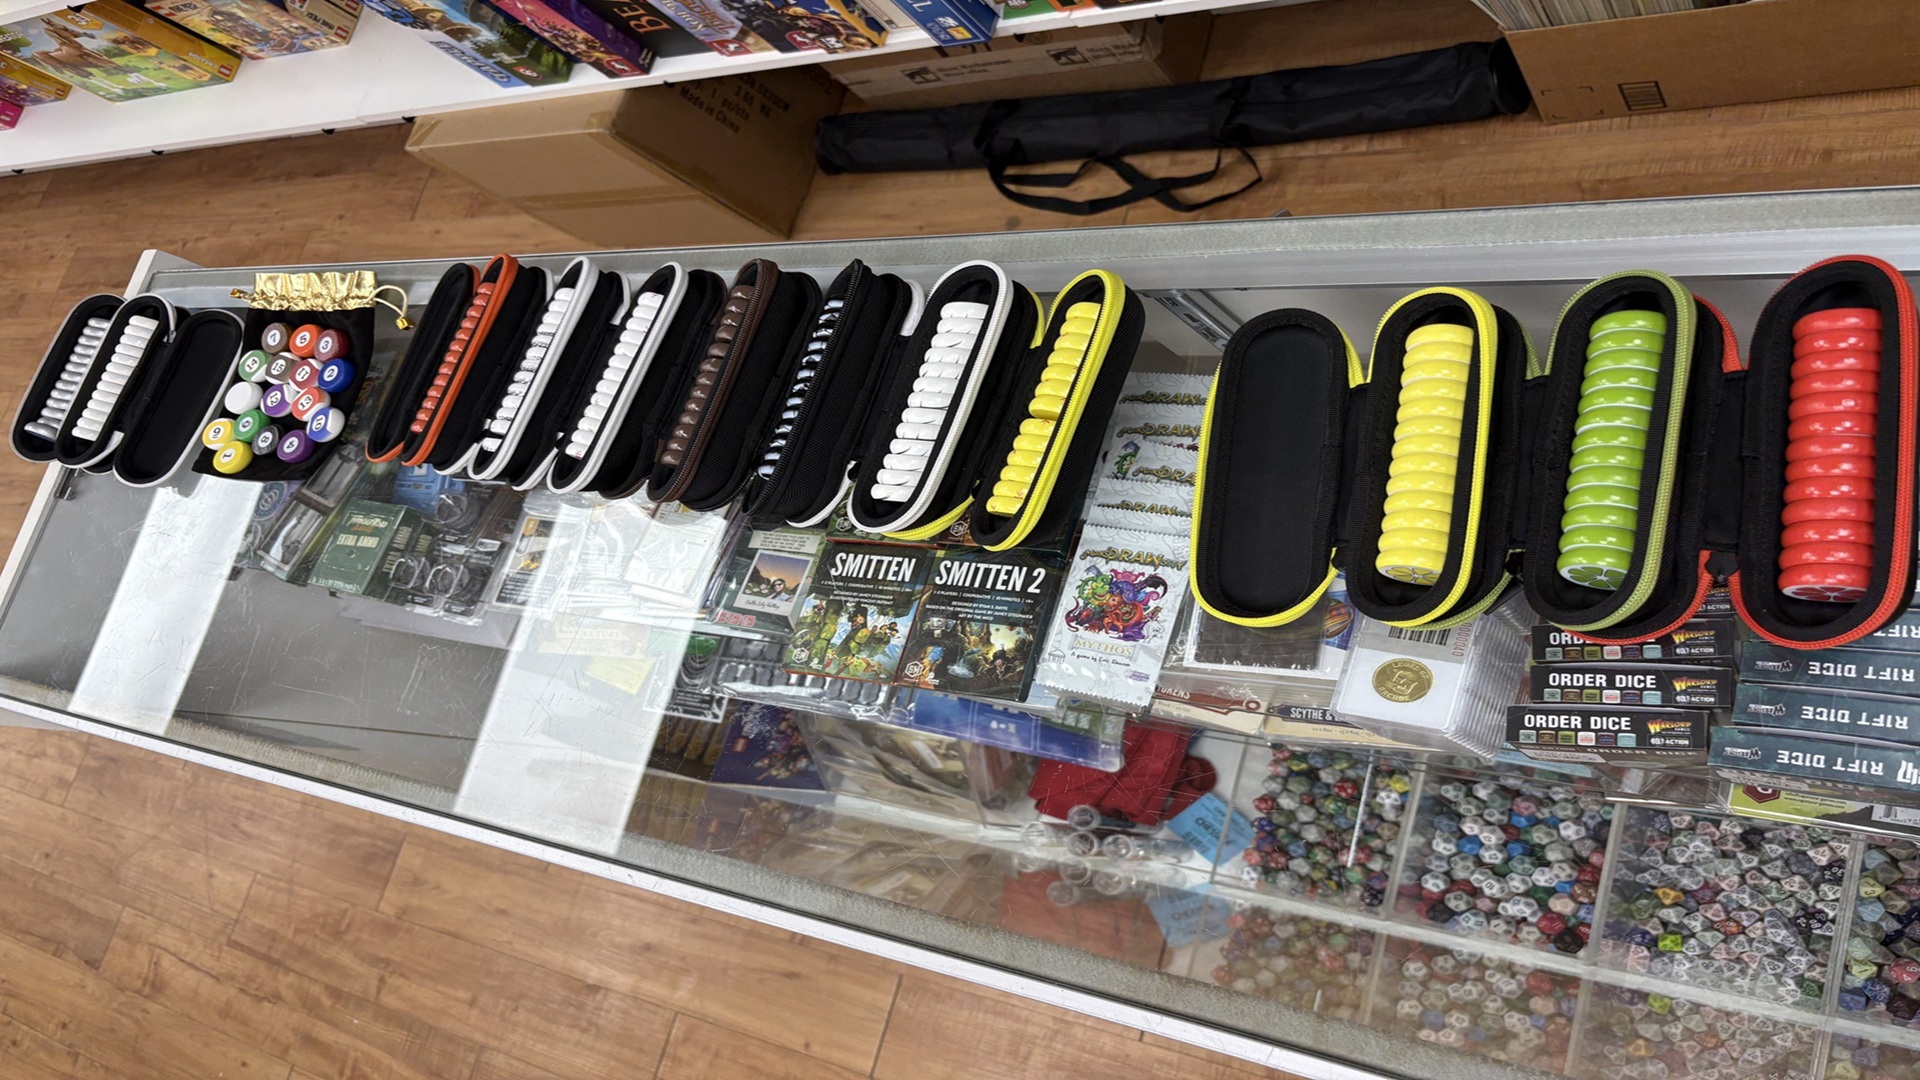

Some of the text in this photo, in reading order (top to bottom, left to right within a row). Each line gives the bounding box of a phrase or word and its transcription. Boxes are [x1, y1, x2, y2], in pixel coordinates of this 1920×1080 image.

[613, 0, 672, 34] BE
[679, 86, 704, 110] Made
[715, 111, 740, 134] China
[336, 533, 380, 548] EXTRA AMMO
[391, 525, 413, 550] AMMO
[831, 552, 917, 582] SMITTEN
[934, 560, 1047, 594] SMITTEN 2
[1550, 632, 1589, 645] ORD
[1671, 629, 1716, 645] WARLORD
[1874, 625, 1920, 638] RIFT
[795, 650, 806, 660] SM
[1074, 639, 1133, 657] MYTHOS
[907, 664, 921, 674] SM
[1808, 661, 1915, 682] RIFT DICE
[1549, 673, 1657, 688] ORDER DICE
[1671, 676, 1718, 692] WARLORD
[1290, 707, 1332, 720] SCYTHE &
[1800, 705, 1909, 729] RIFT DICE
[1524, 714, 1632, 730] ORDER DICE
[1646, 718, 1692, 735] WARLORD
[1776, 750, 1884, 776] RIFT DICE
